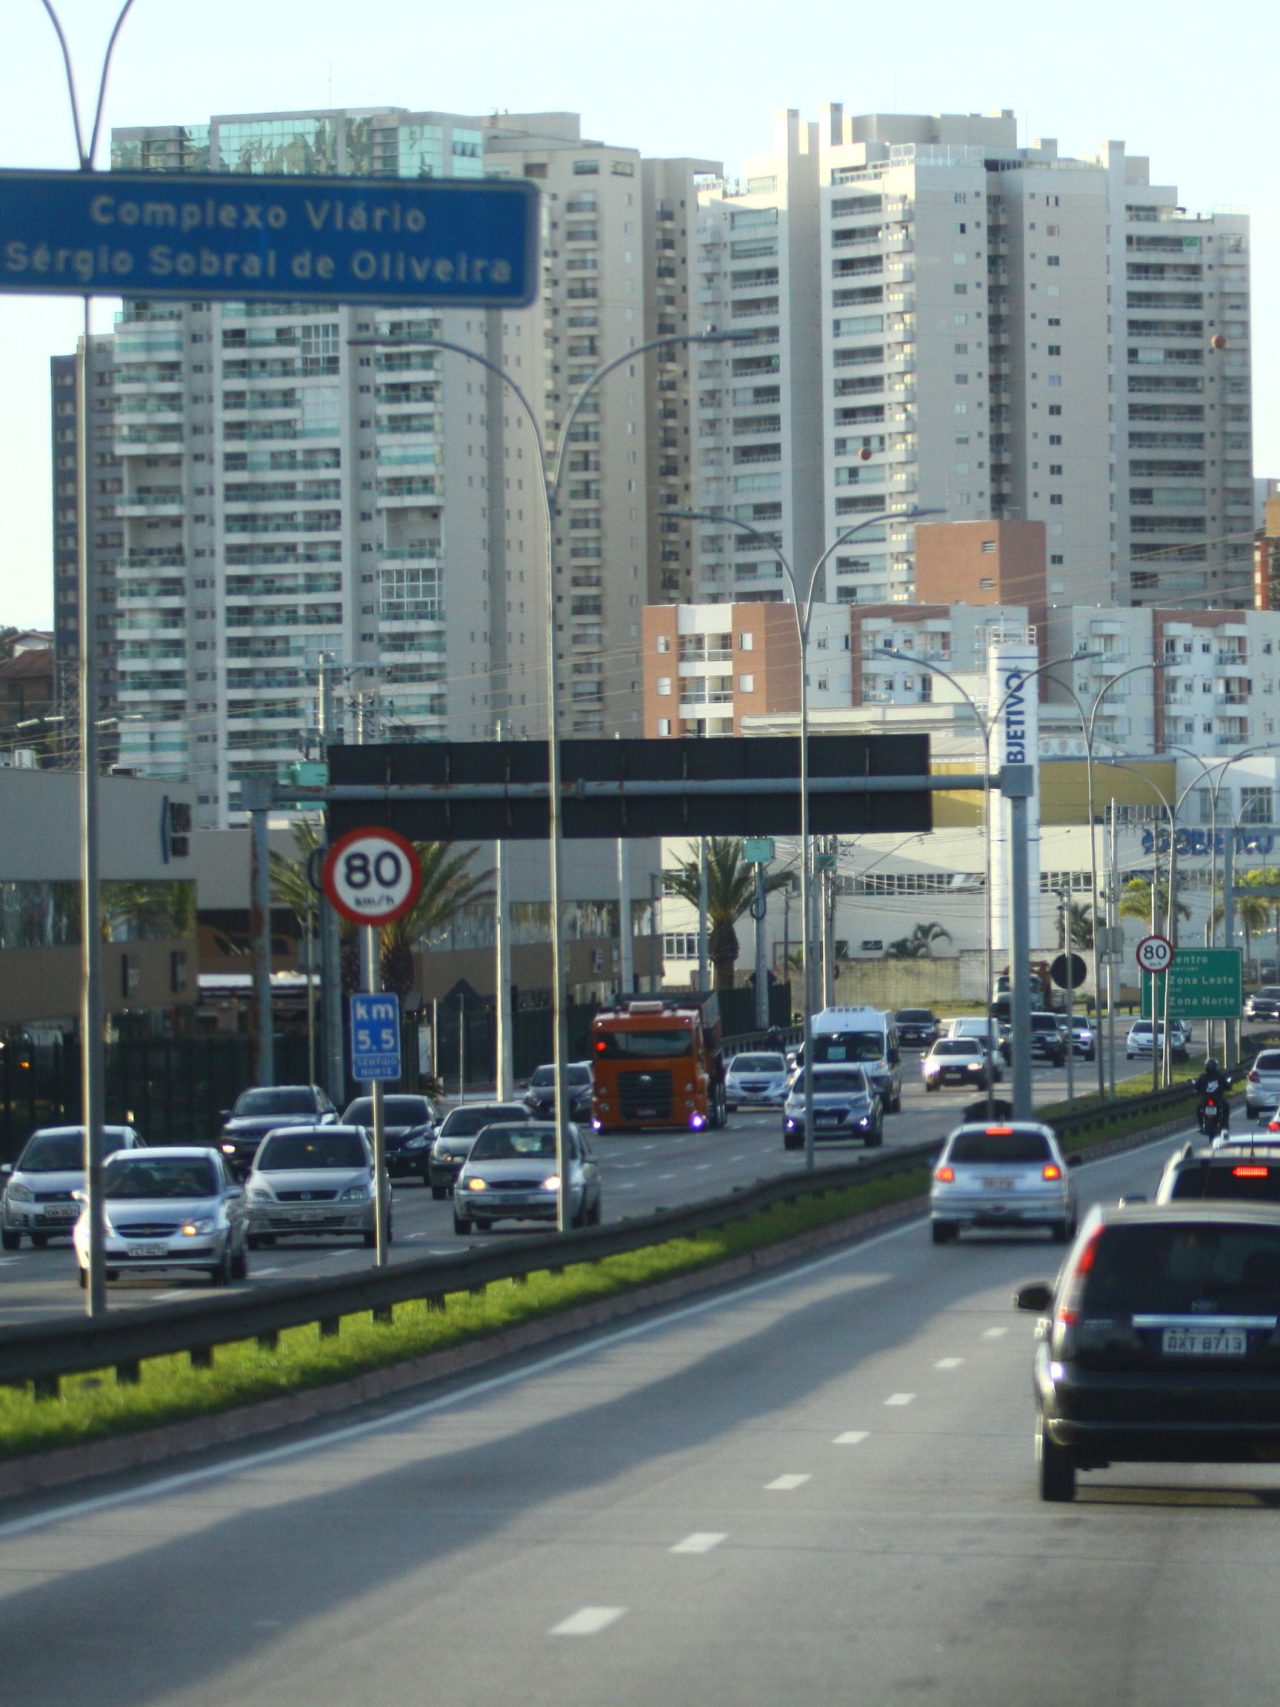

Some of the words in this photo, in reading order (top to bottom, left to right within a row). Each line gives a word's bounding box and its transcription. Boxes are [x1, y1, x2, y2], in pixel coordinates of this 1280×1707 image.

[90, 196, 288, 232] Complexo
[305, 200, 427, 233] Viário
[5, 242, 134, 281] Sérgio
[150, 246, 277, 278] Sobral
[291, 251, 336, 279] de
[352, 250, 512, 284] Oliveira
[1005, 671, 1026, 764] BJETIVO
[345, 850, 403, 891] 80
[354, 894, 395, 907] km/h
[1143, 944, 1167, 960] 80
[1171, 955, 1209, 964] entro
[1169, 976, 1198, 985] Zona
[1202, 976, 1234, 985] Leste
[356, 1000, 394, 1020] km
[1169, 997, 1198, 1006] Zona
[1201, 996, 1235, 1006] Norte
